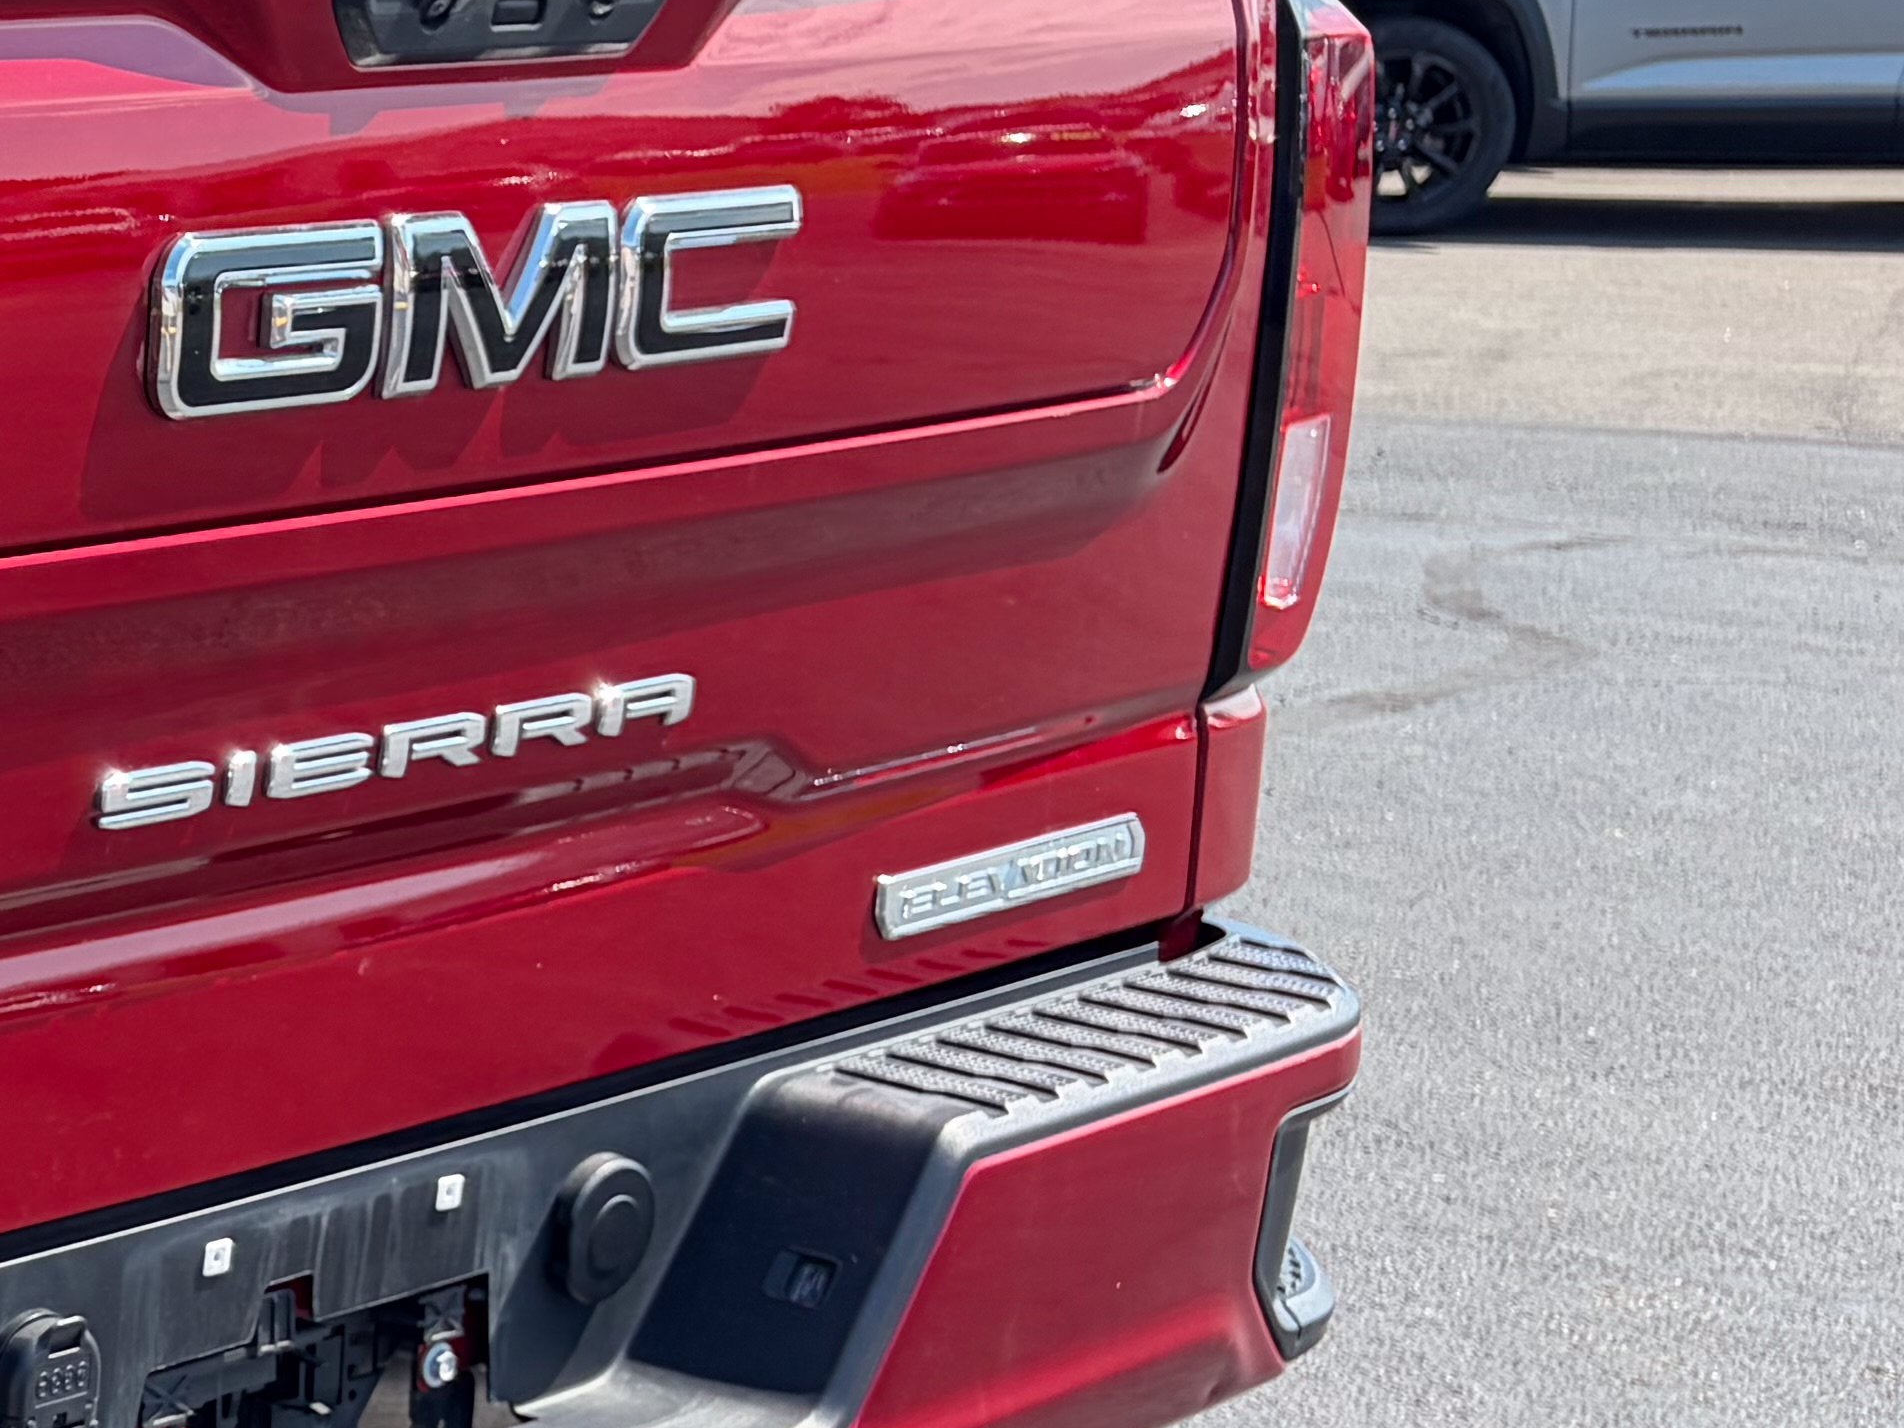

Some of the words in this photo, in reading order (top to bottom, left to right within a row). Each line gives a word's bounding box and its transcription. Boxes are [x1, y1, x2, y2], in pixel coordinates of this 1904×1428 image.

[143, 184, 803, 421] GMC
[96, 672, 695, 830] SIERRA
[899, 830, 1128, 919] ELEVATION
